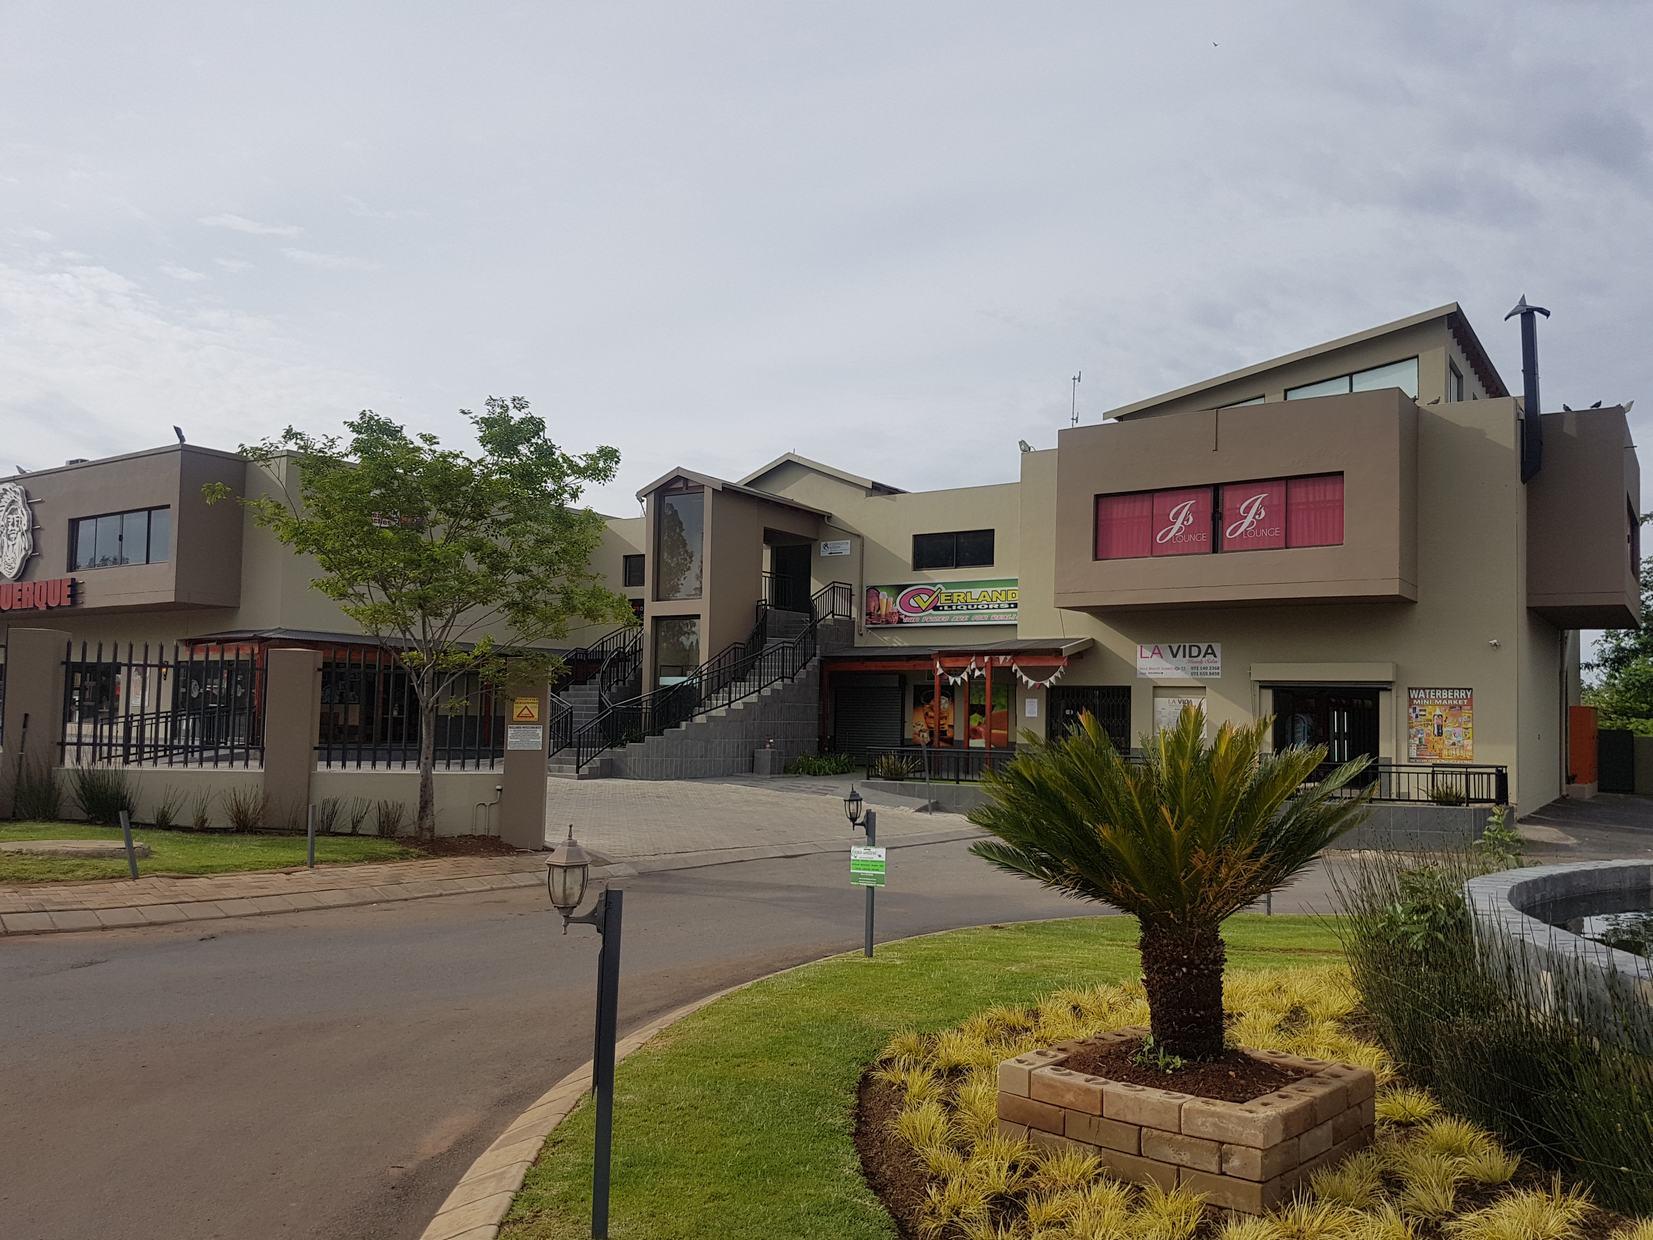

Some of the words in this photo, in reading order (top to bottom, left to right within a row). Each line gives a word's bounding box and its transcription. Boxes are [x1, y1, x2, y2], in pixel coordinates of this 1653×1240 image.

[1172, 532, 1207, 543] LOUNGE
[1243, 527, 1281, 539] LOUNGE
[1139, 644, 1164, 659] LA
[1168, 643, 1217, 659] VIDA
[1409, 689, 1472, 699] WATERBERRY
